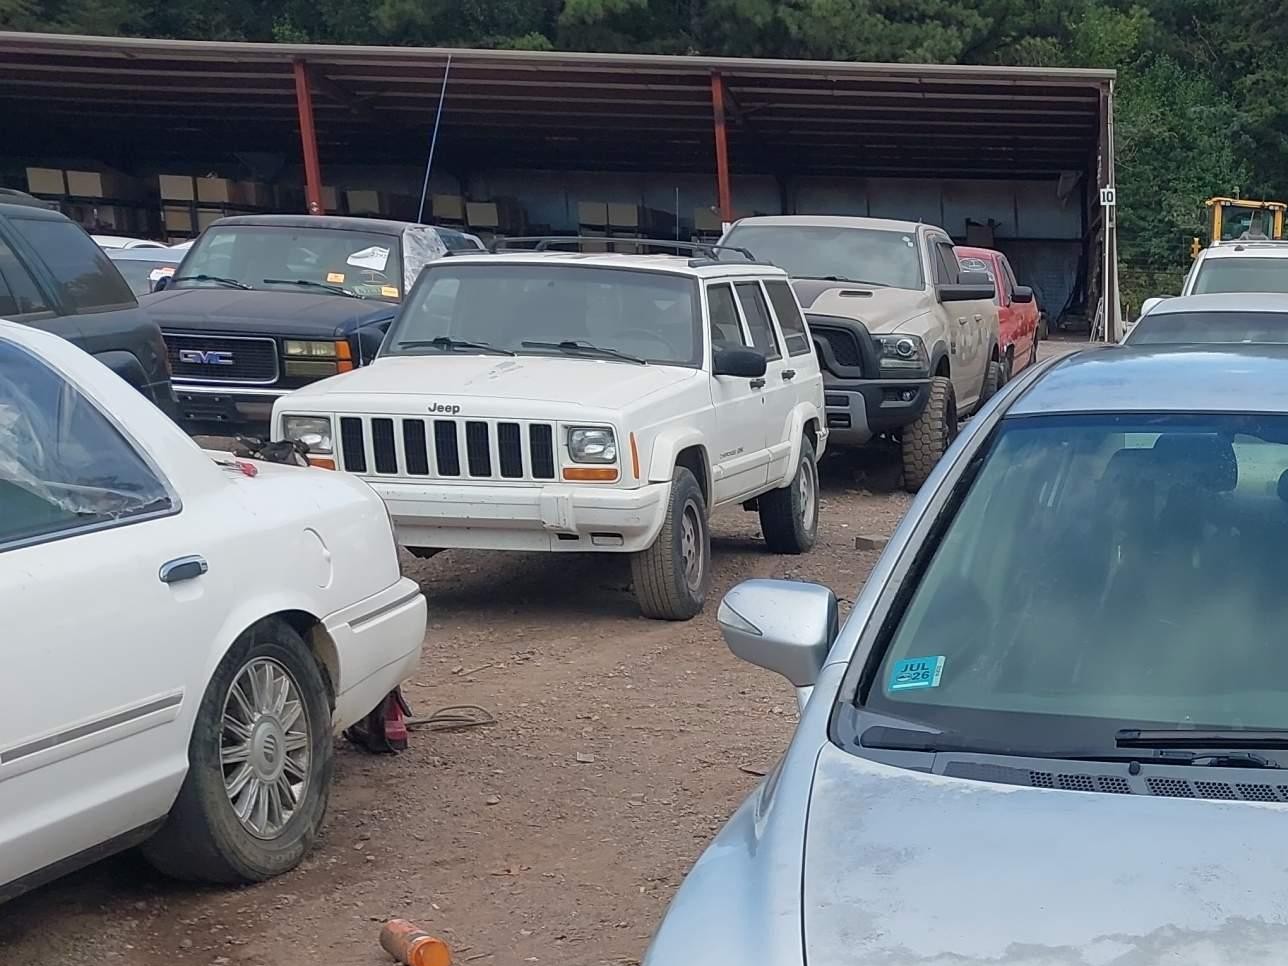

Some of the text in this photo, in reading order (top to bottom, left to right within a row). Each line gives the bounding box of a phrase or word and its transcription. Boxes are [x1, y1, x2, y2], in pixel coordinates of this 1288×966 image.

[1102, 191, 1113, 202] 10
[179, 349, 233, 365] GMC
[428, 402, 460, 415] Jeep
[901, 662, 929, 673] JUL
[911, 671, 930, 681] 26
